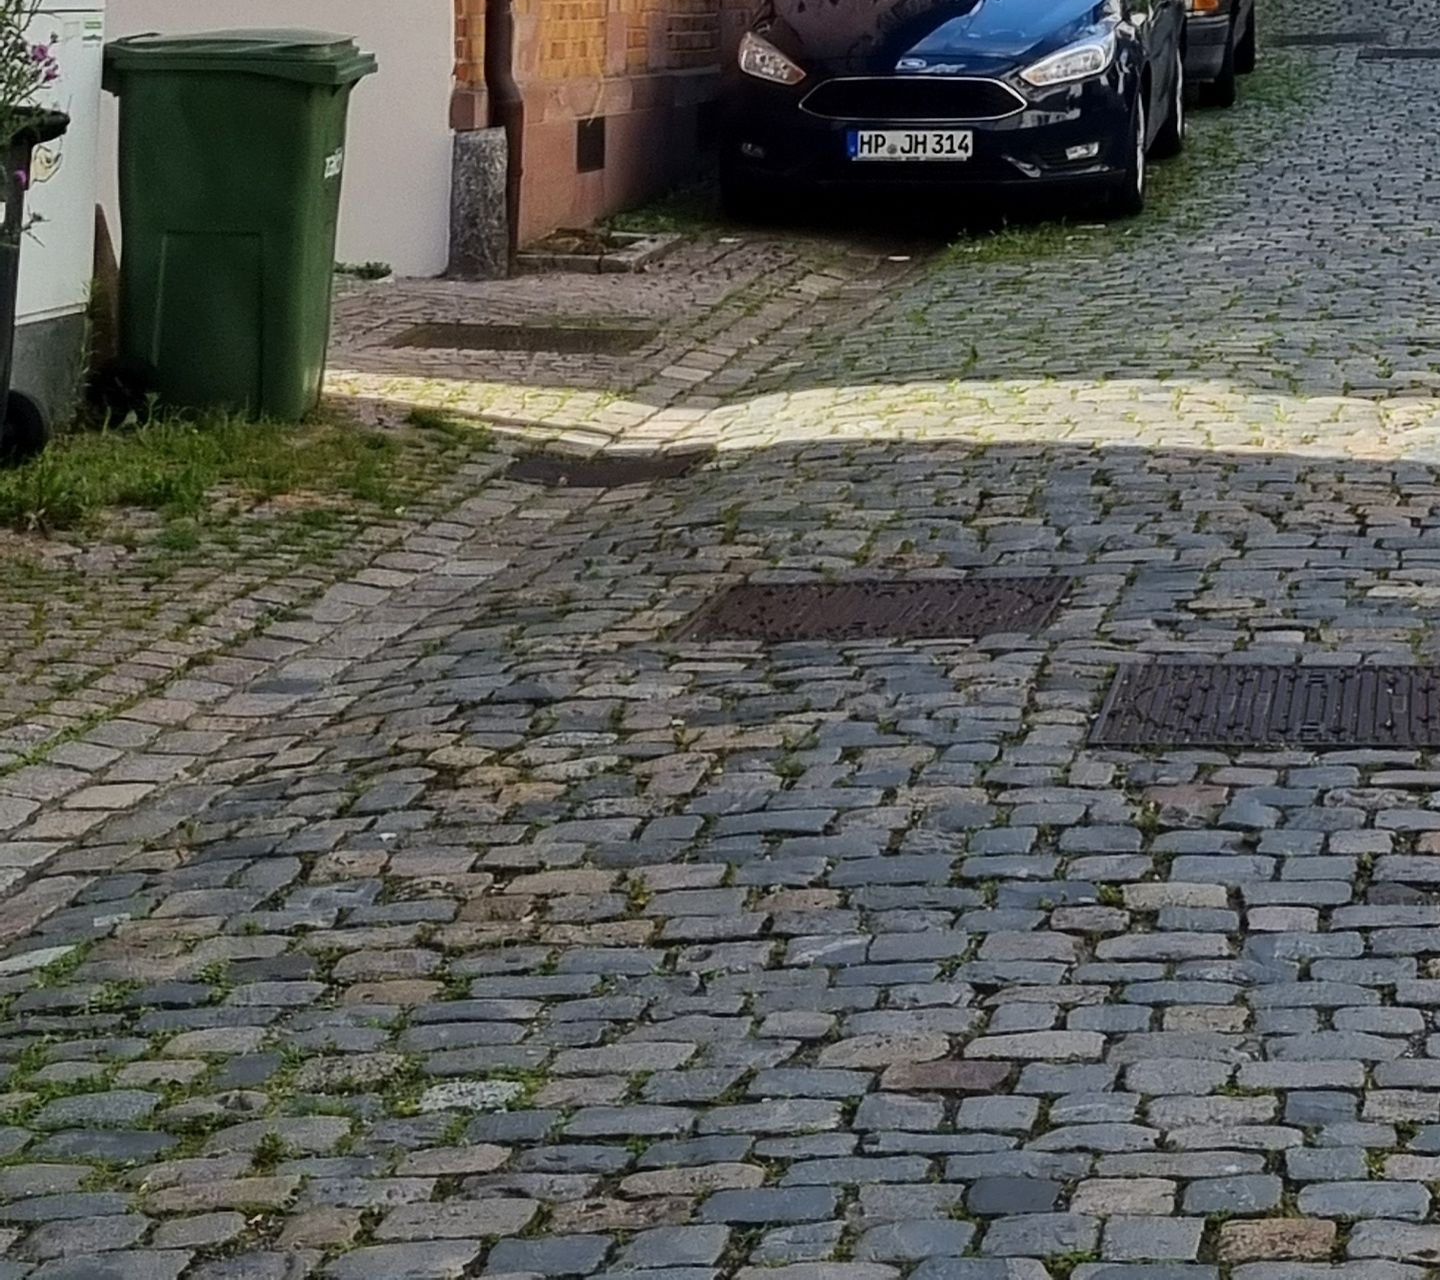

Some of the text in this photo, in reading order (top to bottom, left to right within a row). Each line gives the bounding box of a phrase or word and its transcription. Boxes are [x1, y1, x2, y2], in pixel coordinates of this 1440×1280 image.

[860, 134, 969, 154] HP JH 314
